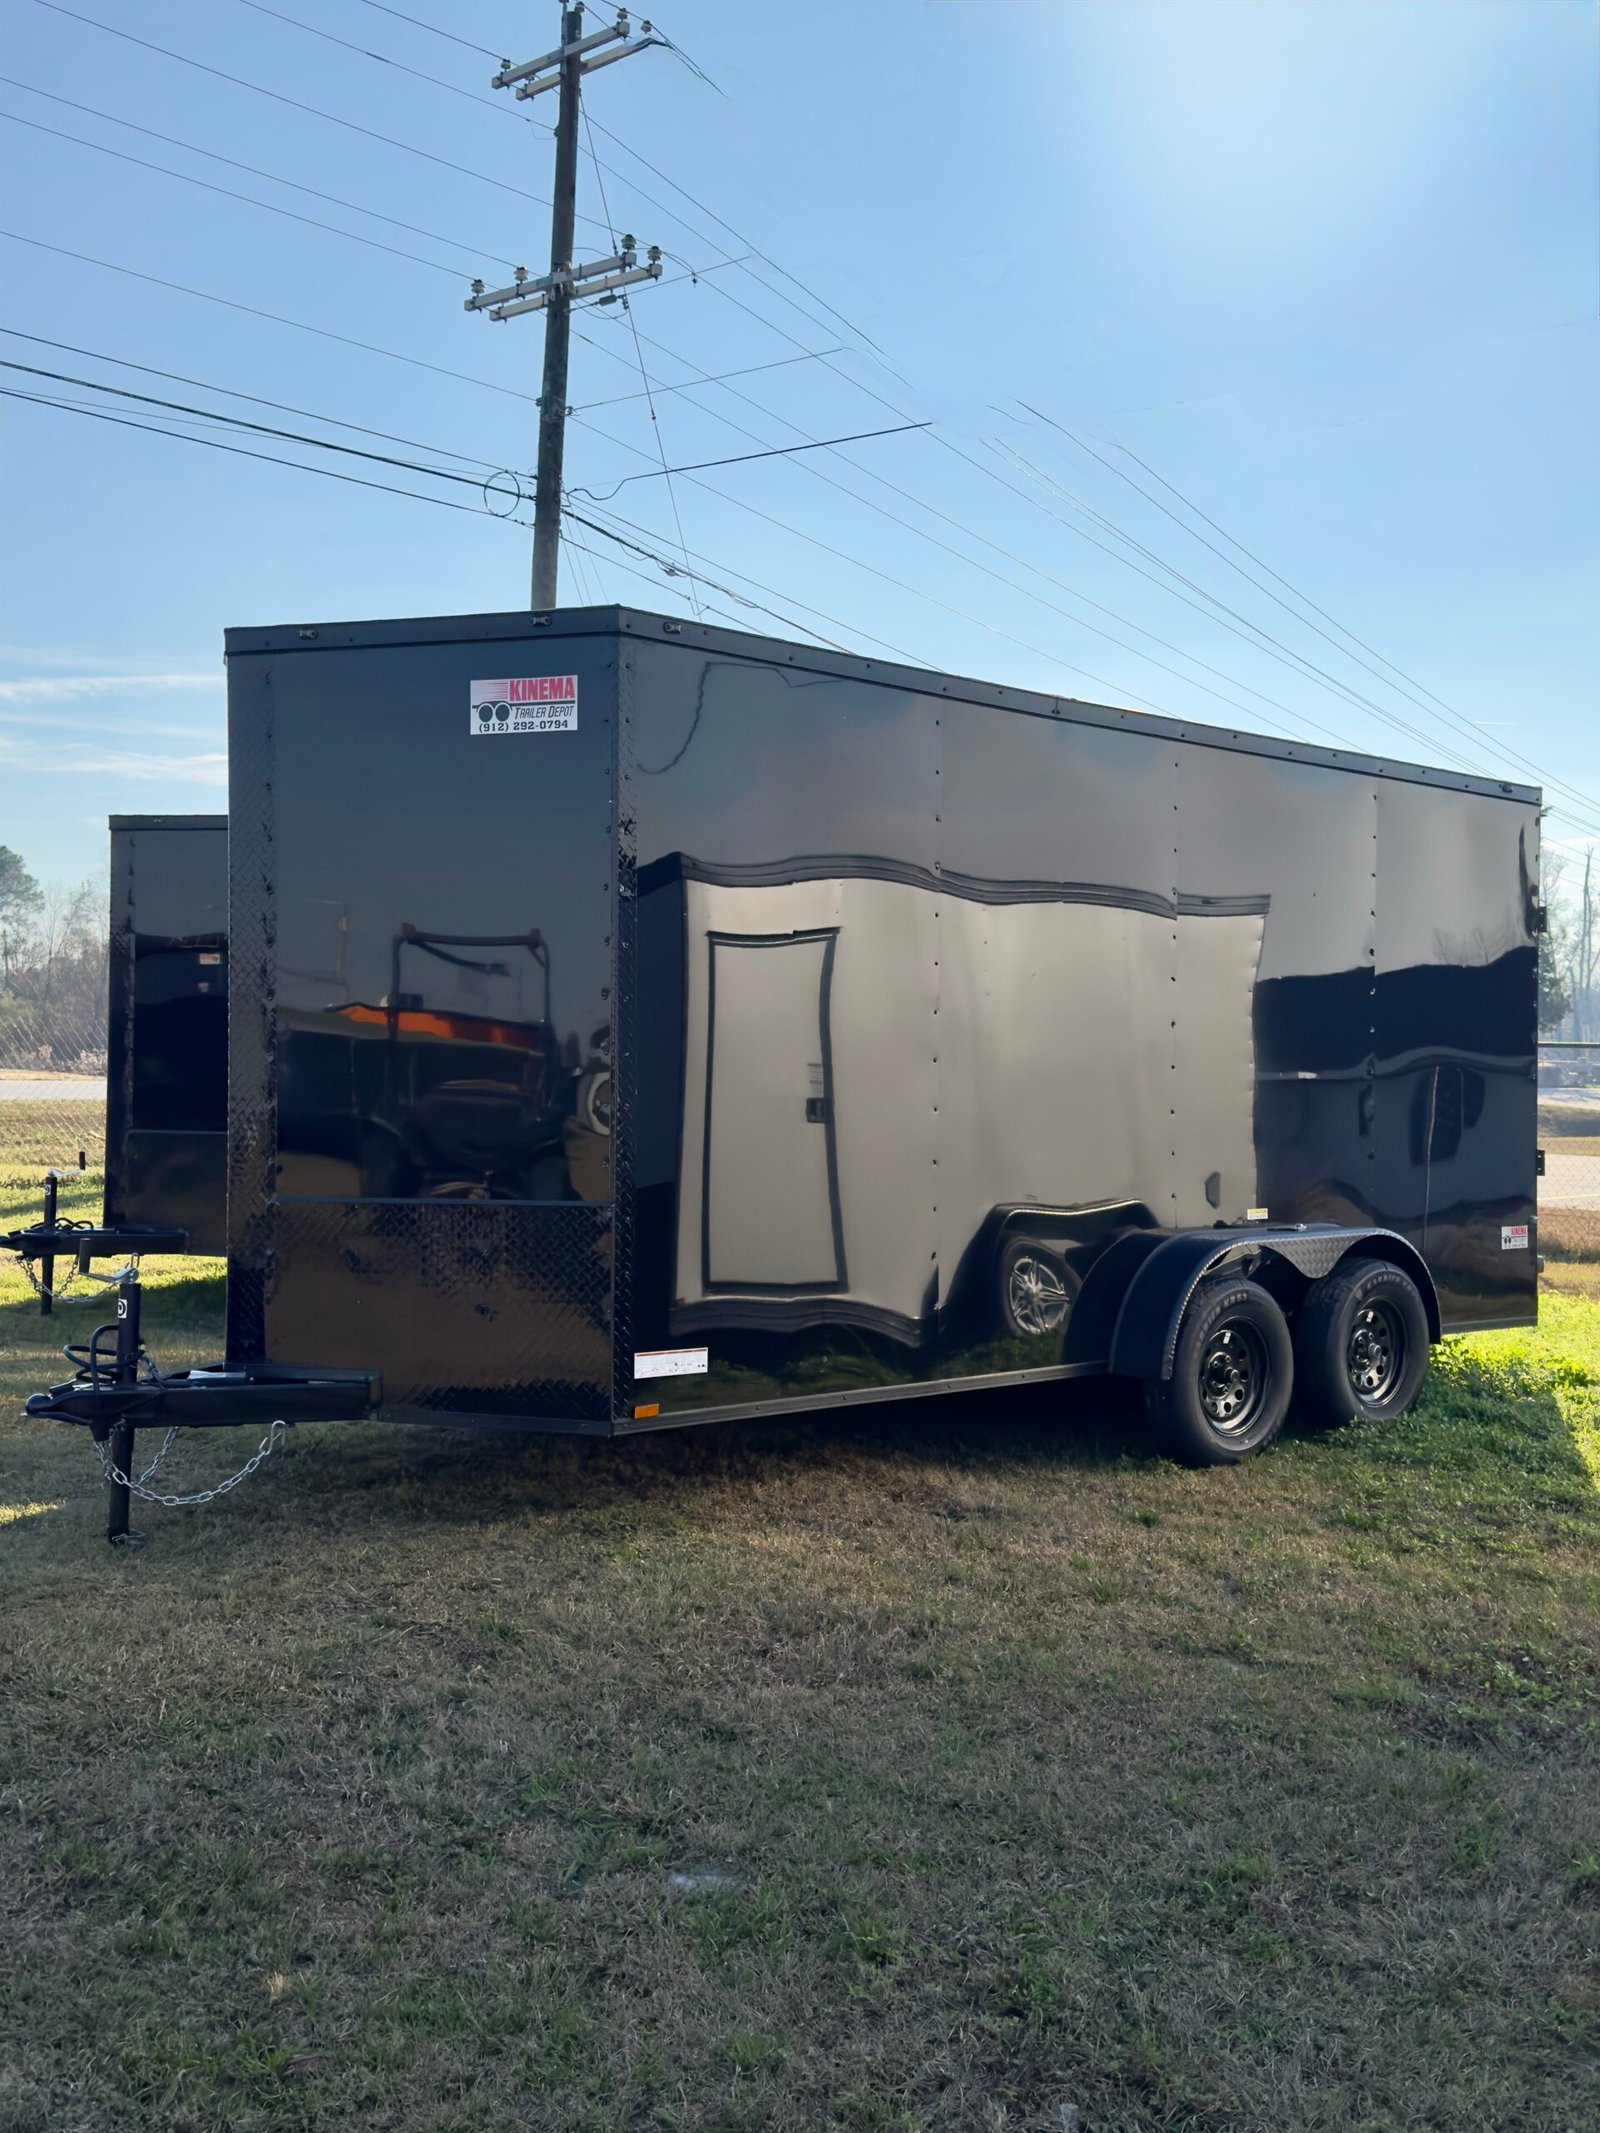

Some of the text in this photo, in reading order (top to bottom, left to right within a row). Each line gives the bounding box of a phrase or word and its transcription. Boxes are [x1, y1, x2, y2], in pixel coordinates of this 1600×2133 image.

[509, 676, 575, 702] KINEMA
[514, 705, 574, 719] TRAILER DEPOT
[479, 720, 568, 733] (912) 292-0794
